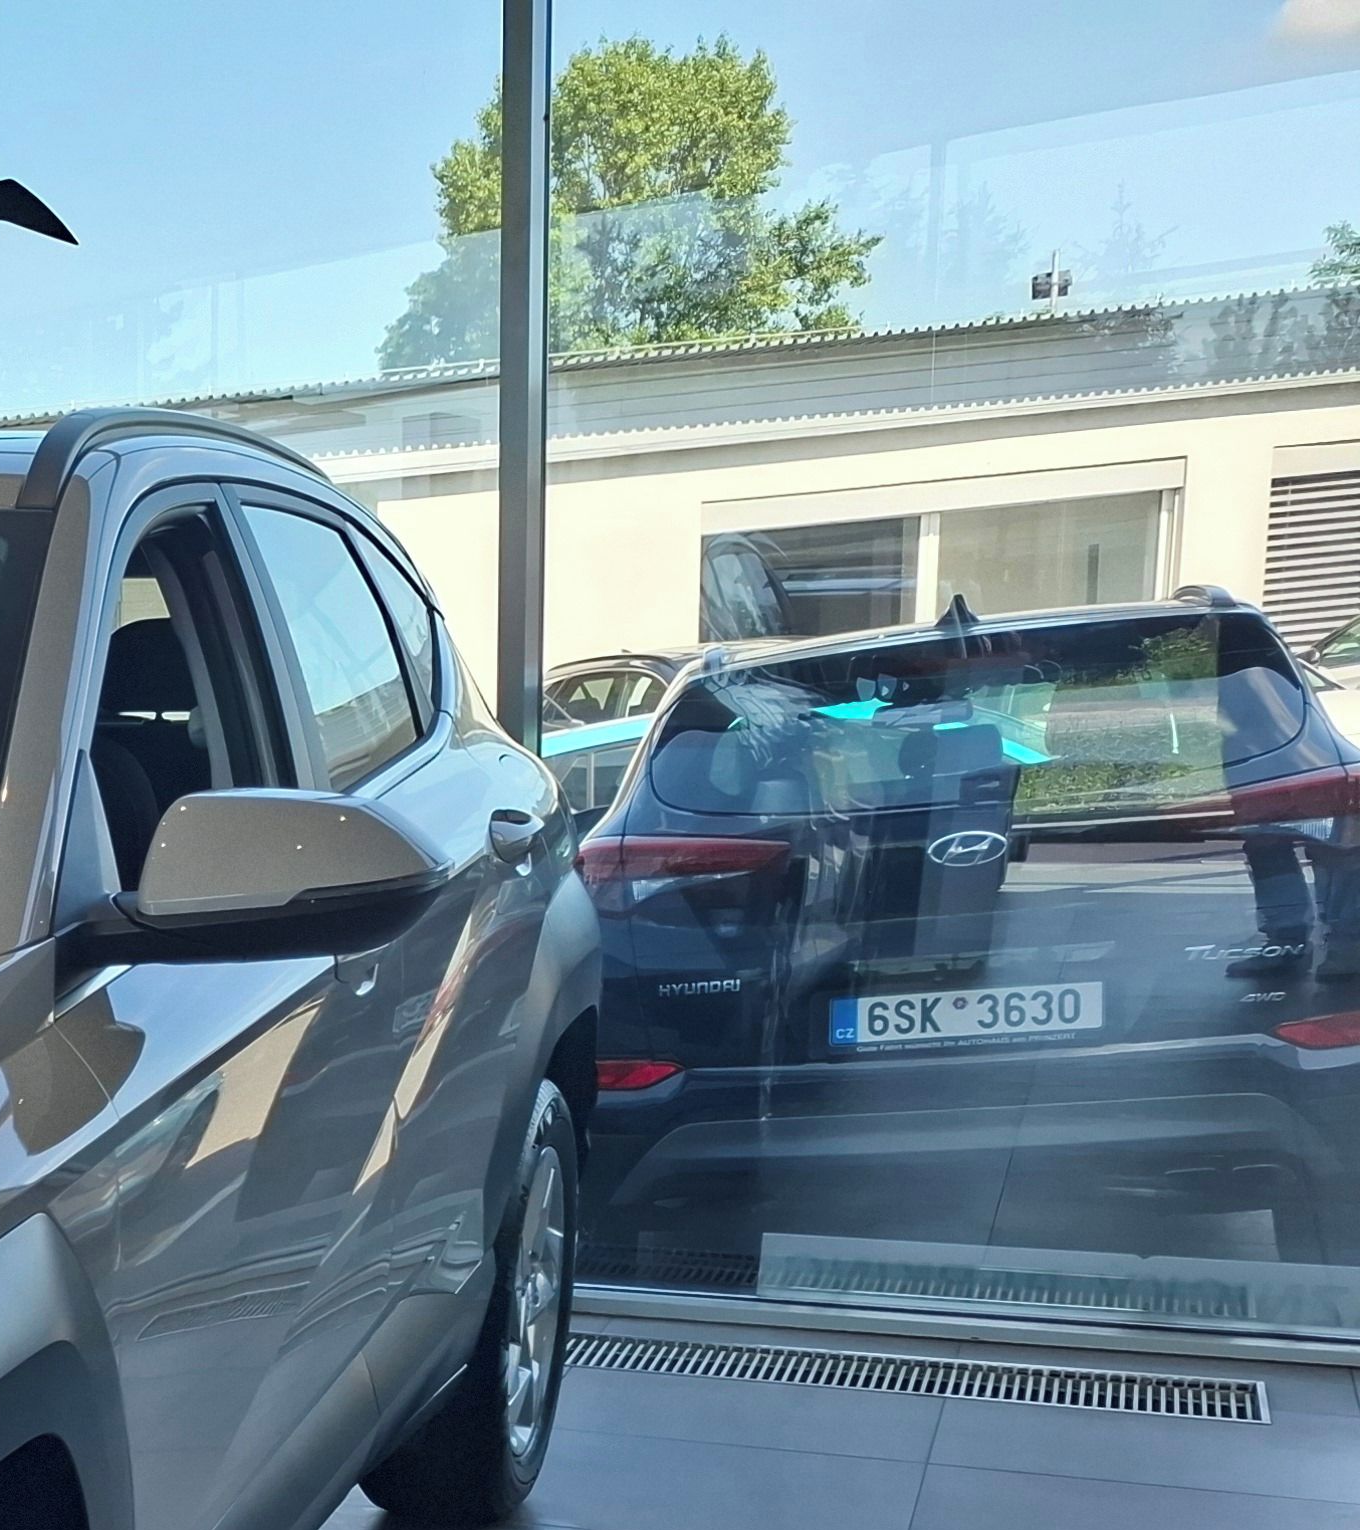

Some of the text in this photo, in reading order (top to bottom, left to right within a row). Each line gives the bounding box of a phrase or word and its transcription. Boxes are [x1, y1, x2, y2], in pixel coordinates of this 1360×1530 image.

[1183, 943, 1305, 961] TUCSON
[659, 978, 741, 997] HYUNDAI
[835, 988, 1081, 1040] CZ 6SK 3630
